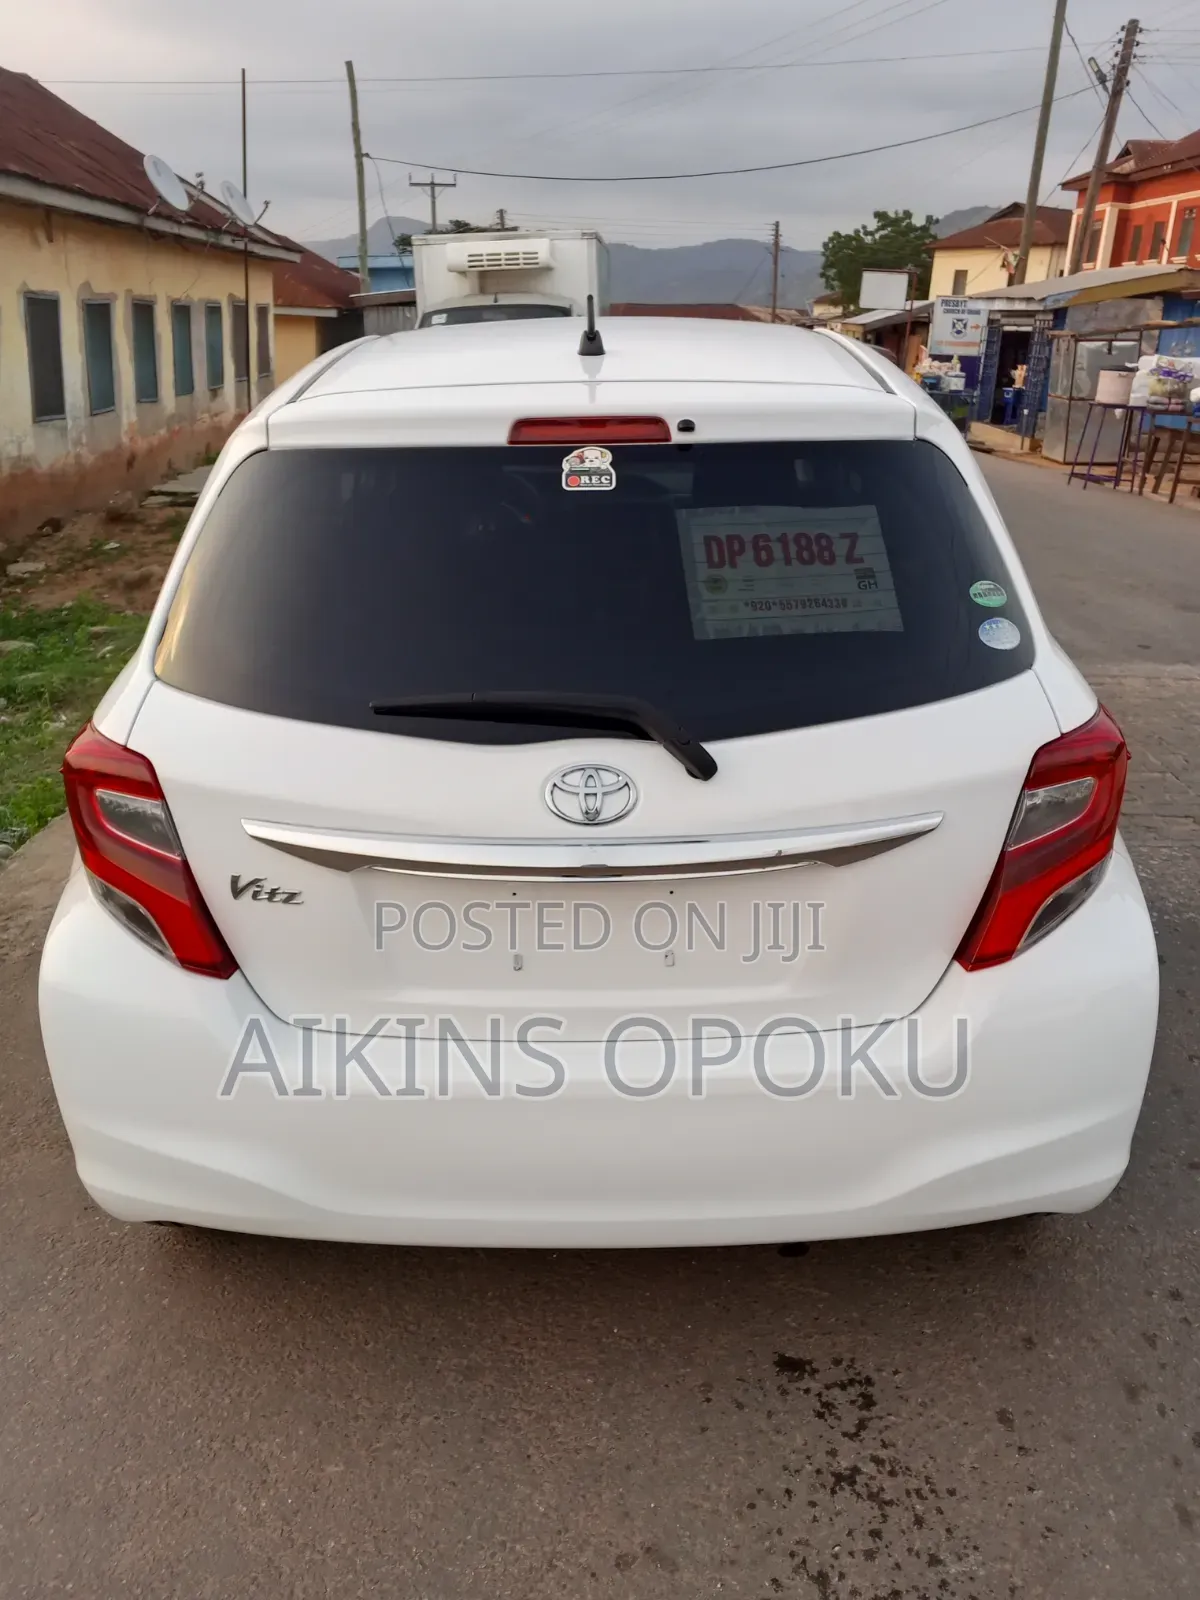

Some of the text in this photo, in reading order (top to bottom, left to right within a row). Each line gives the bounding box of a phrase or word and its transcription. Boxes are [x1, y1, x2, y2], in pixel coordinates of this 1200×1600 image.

[580, 475, 610, 484] REC
[703, 532, 865, 569] DP 6188 Z
[857, 580, 878, 590] GH
[230, 873, 305, 906] Vitz
